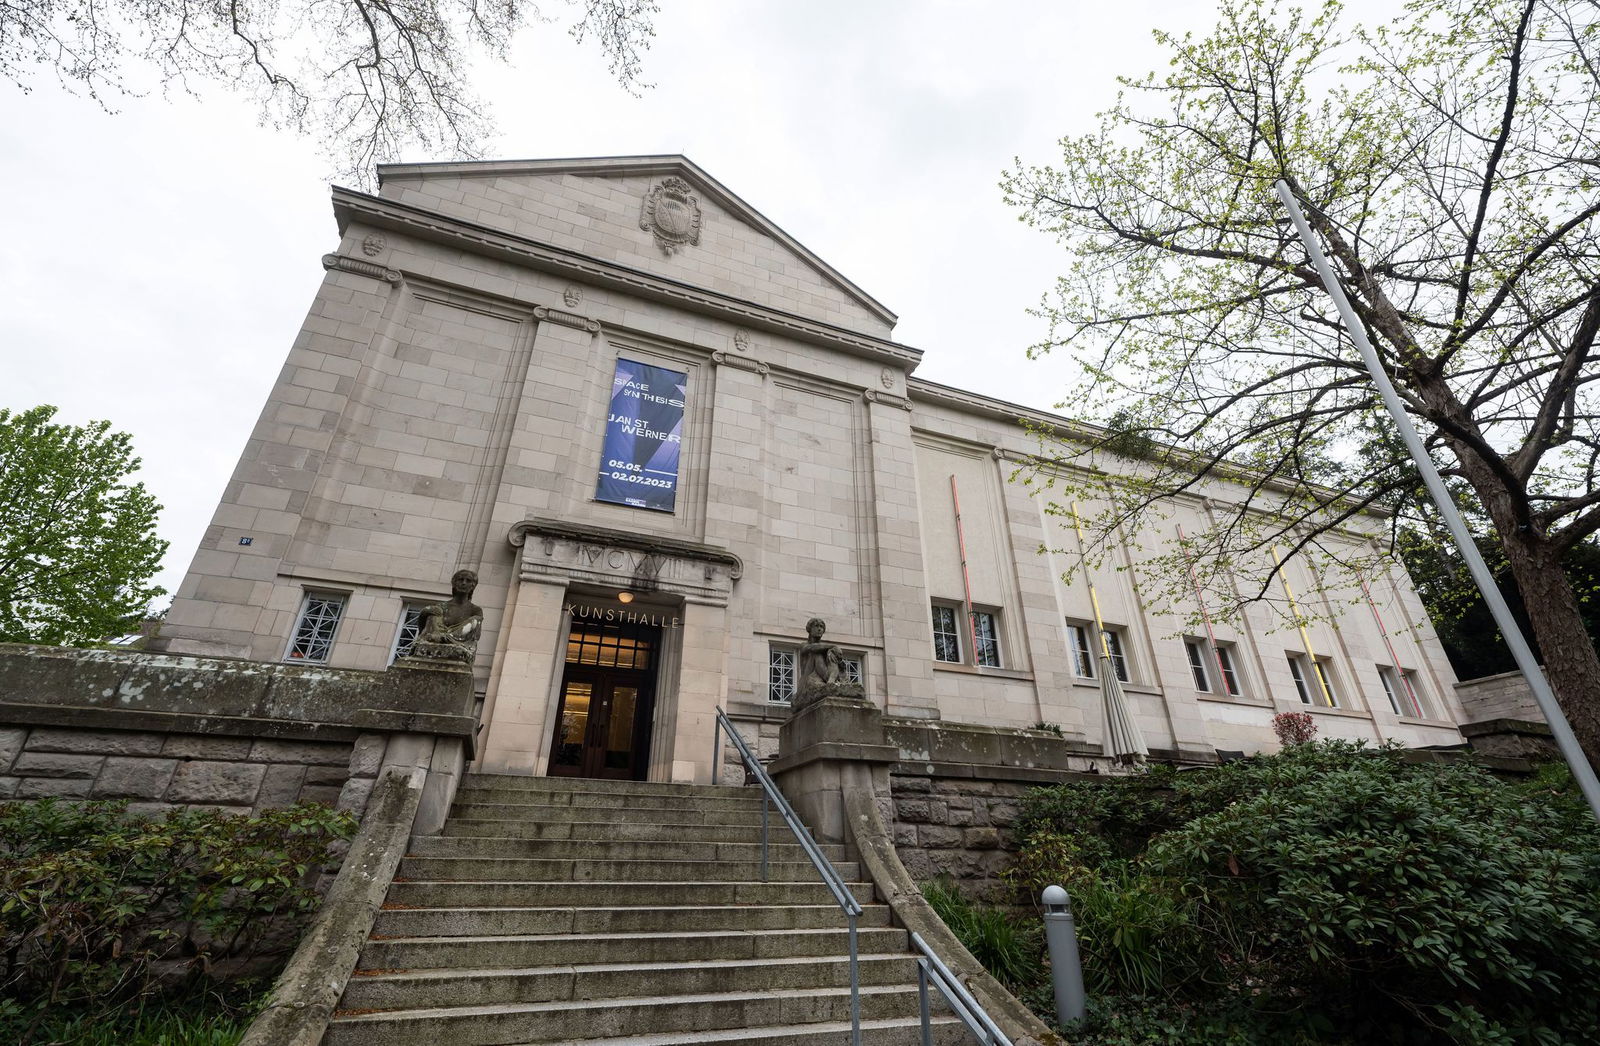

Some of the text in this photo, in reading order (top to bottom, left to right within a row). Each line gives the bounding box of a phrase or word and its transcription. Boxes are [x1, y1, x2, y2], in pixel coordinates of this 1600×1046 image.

[614, 377, 649, 391] SPACE
[624, 388, 684, 408] SYNTHESIS
[608, 413, 631, 425] JAN
[621, 424, 681, 443] WERNER
[609, 459, 643, 472] 05.05.
[611, 471, 673, 489] 02.07.2023
[567, 604, 680, 629] KUNSTHALLE
